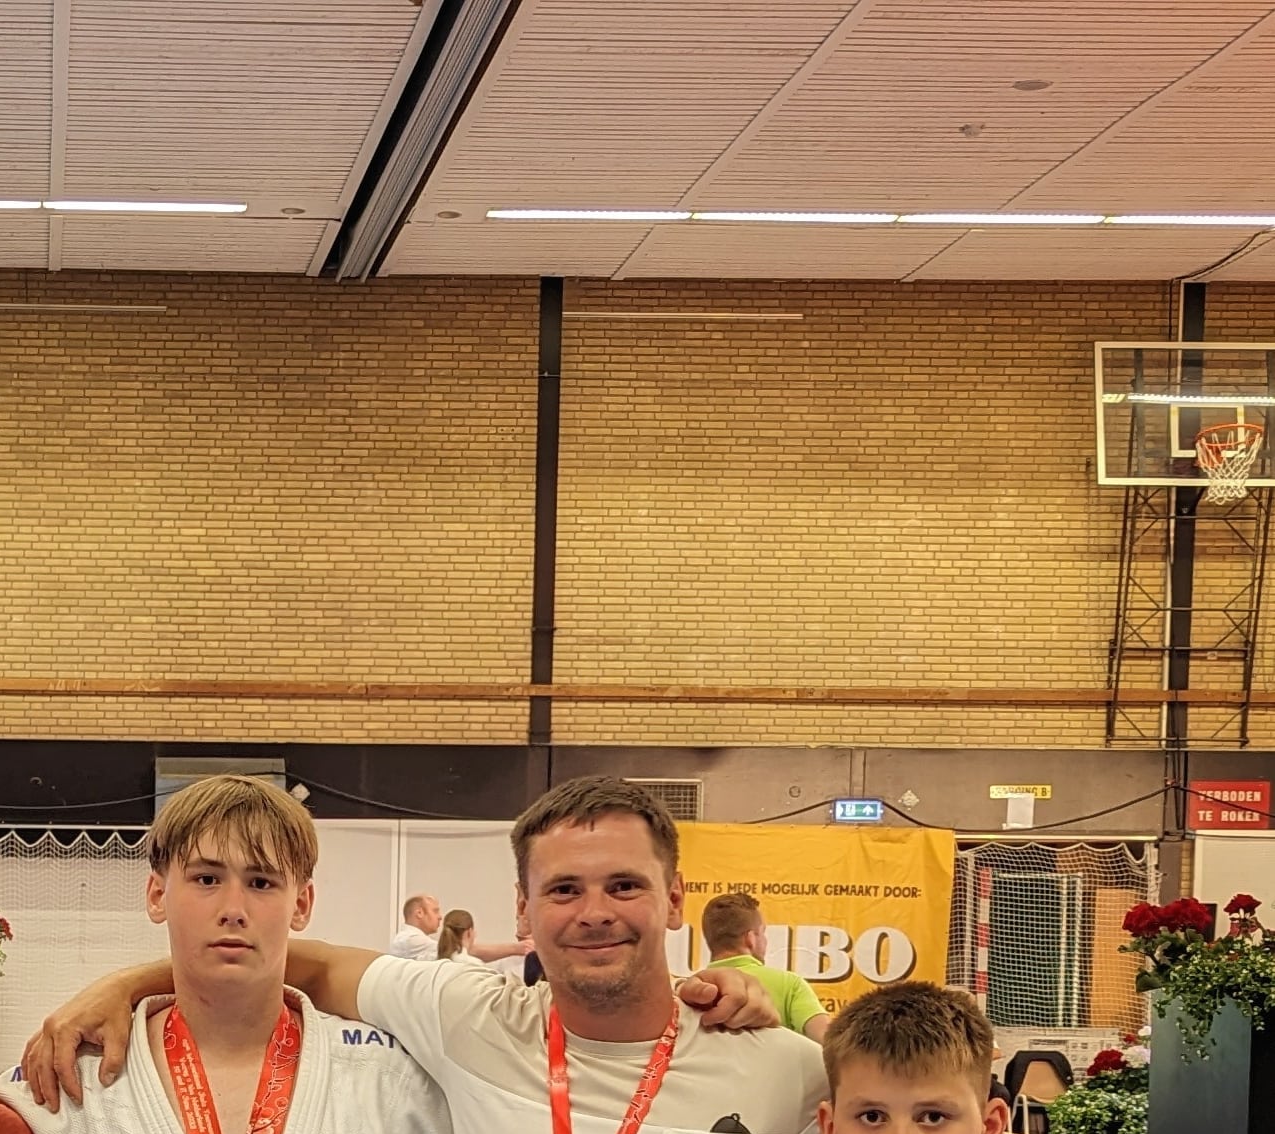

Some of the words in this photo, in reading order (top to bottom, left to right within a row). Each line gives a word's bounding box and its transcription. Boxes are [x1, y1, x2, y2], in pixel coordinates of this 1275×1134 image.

[1198, 790, 1261, 801] VERBODEN
[1197, 810, 1213, 821] TE
[1221, 810, 1260, 821] ROKEN
[713, 882, 723, 893] IS
[727, 882, 757, 894] MEDE
[761, 883, 819, 896] MOGELIJK
[824, 884, 880, 897] GEMAAKT
[883, 886, 922, 898] DOOR:
[342, 1029, 410, 1055] MAT
